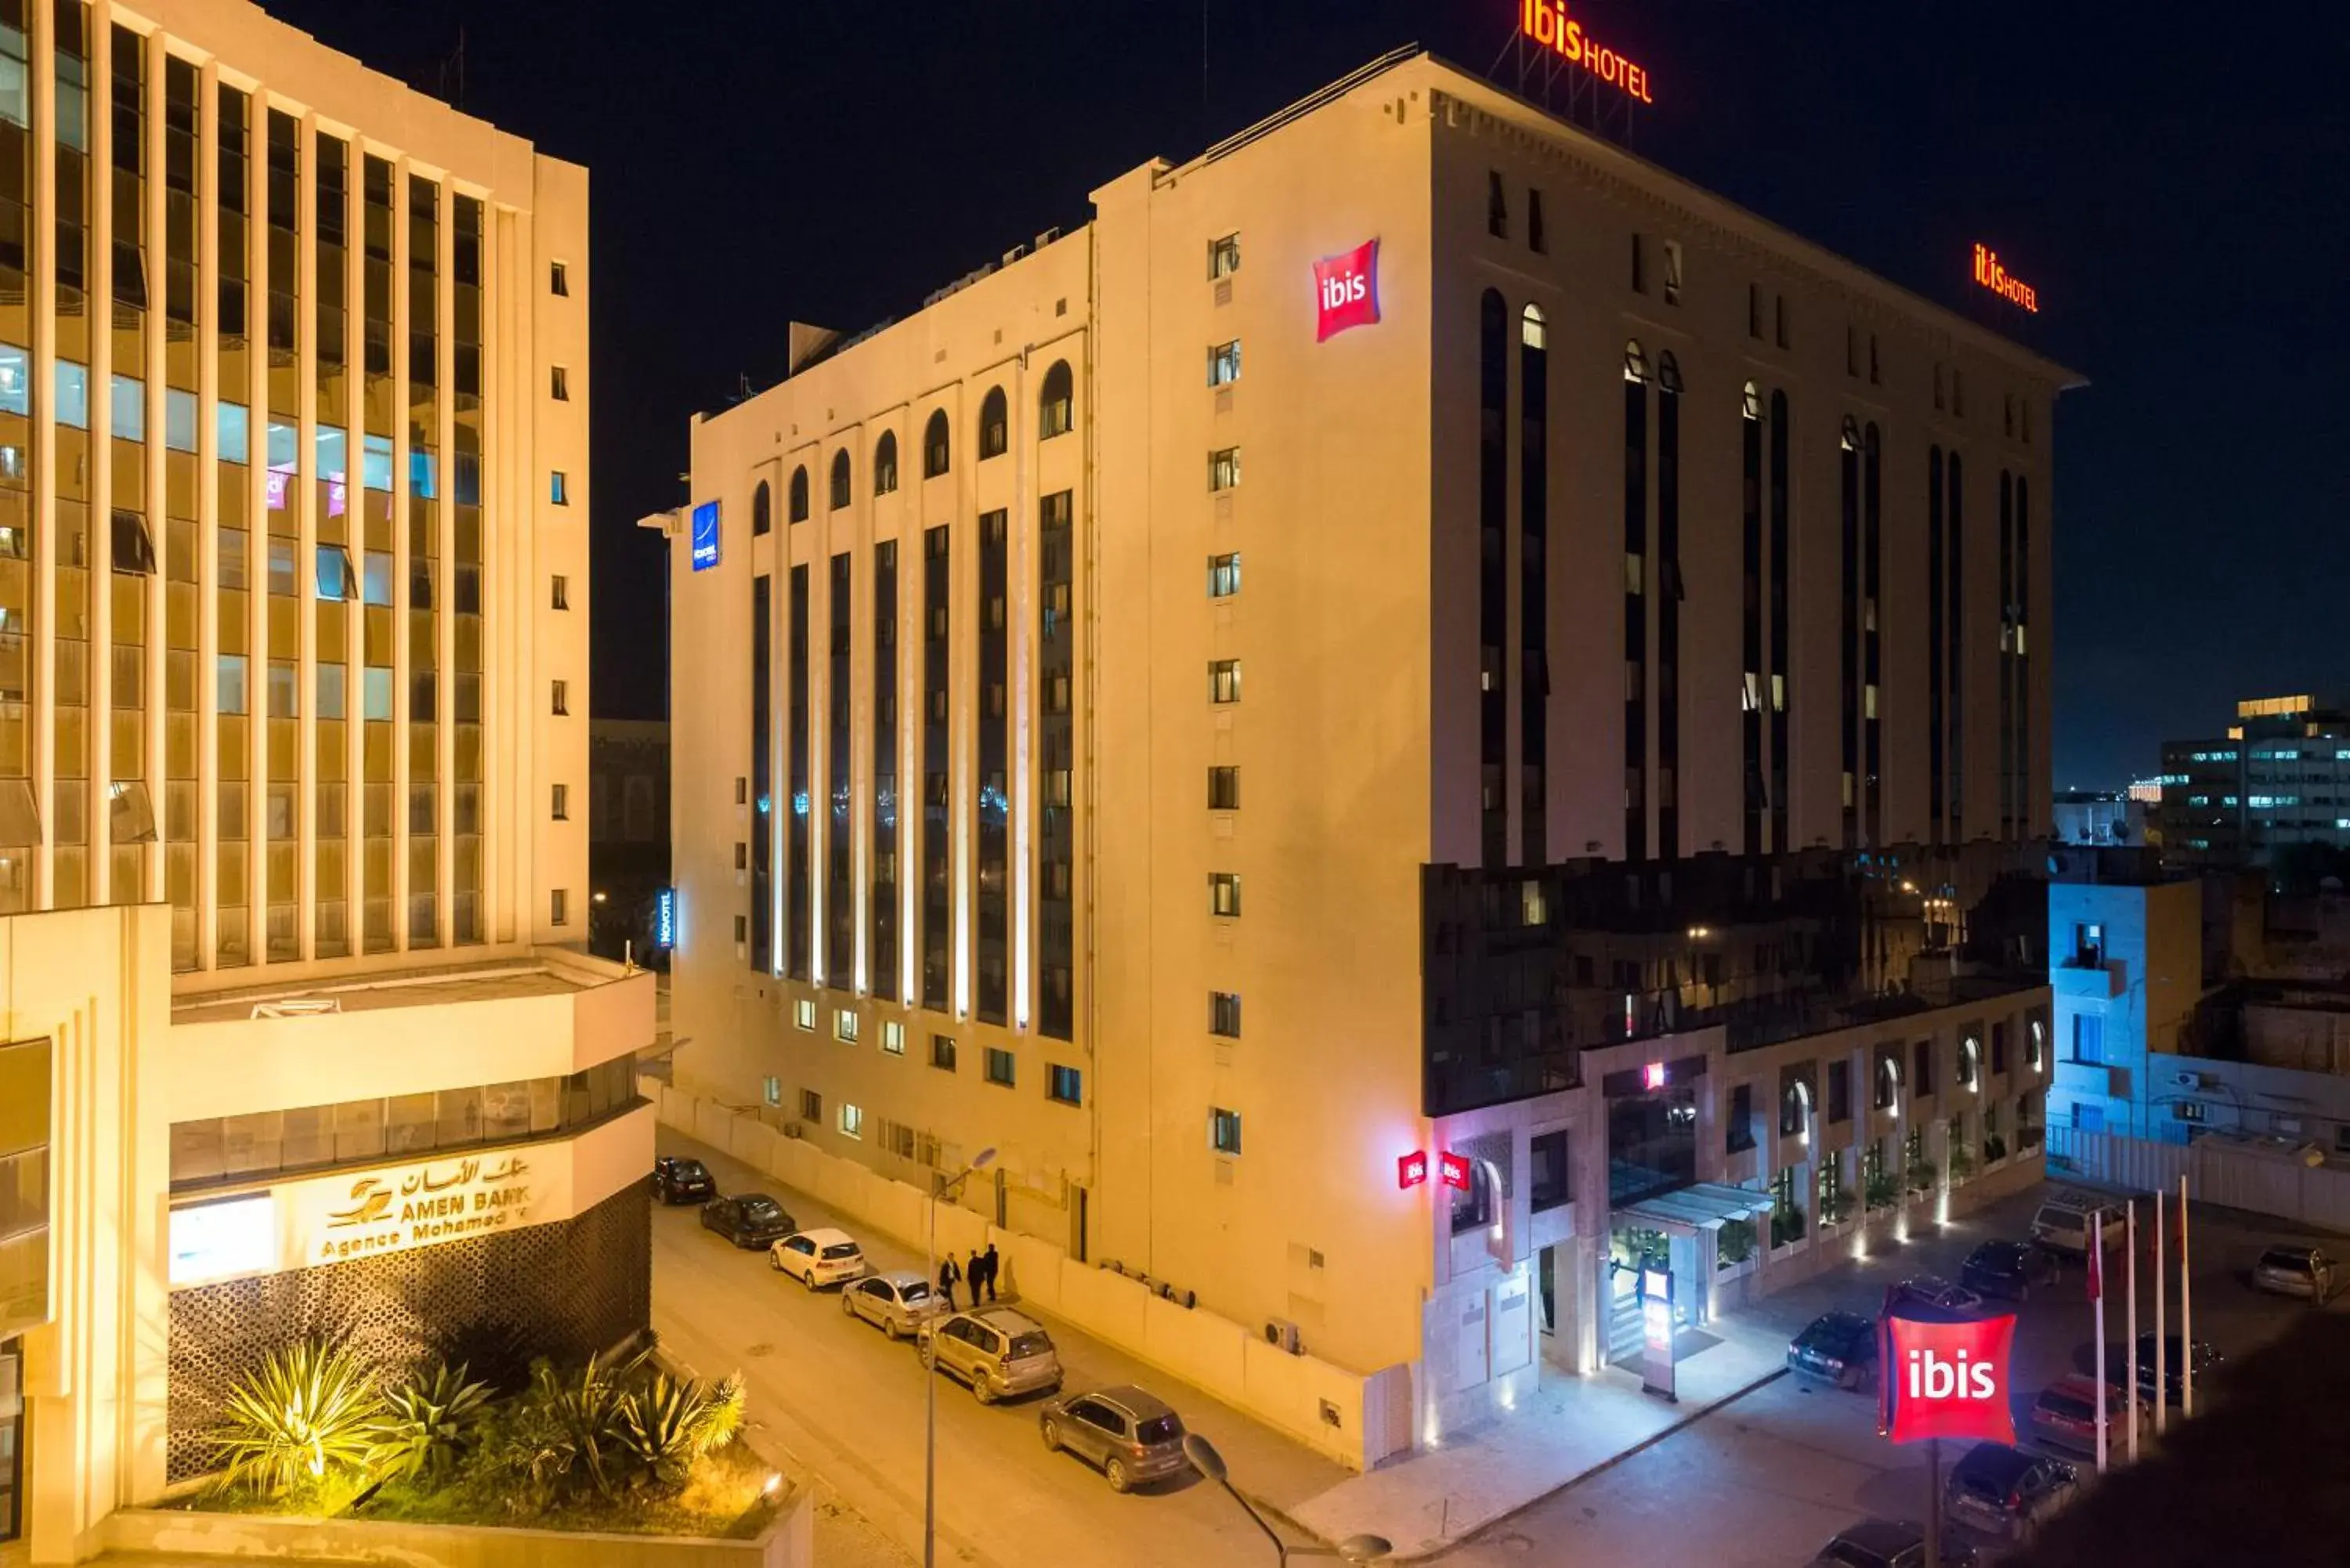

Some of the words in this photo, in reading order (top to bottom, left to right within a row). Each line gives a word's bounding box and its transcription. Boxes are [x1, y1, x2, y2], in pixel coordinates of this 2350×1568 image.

[1524, 0, 1581, 61] ibis
[1584, 38, 1652, 103] HOTEL
[1322, 270, 1365, 311] ibis
[1975, 243, 2005, 294] ibis
[2005, 275, 2038, 313] HOTEL
[400, 1195, 465, 1223] AMEN
[475, 1187, 532, 1211] BANK
[322, 1231, 400, 1258] Agence
[413, 1211, 506, 1241] Mohamed
[1909, 1349, 1995, 1400] ibis
